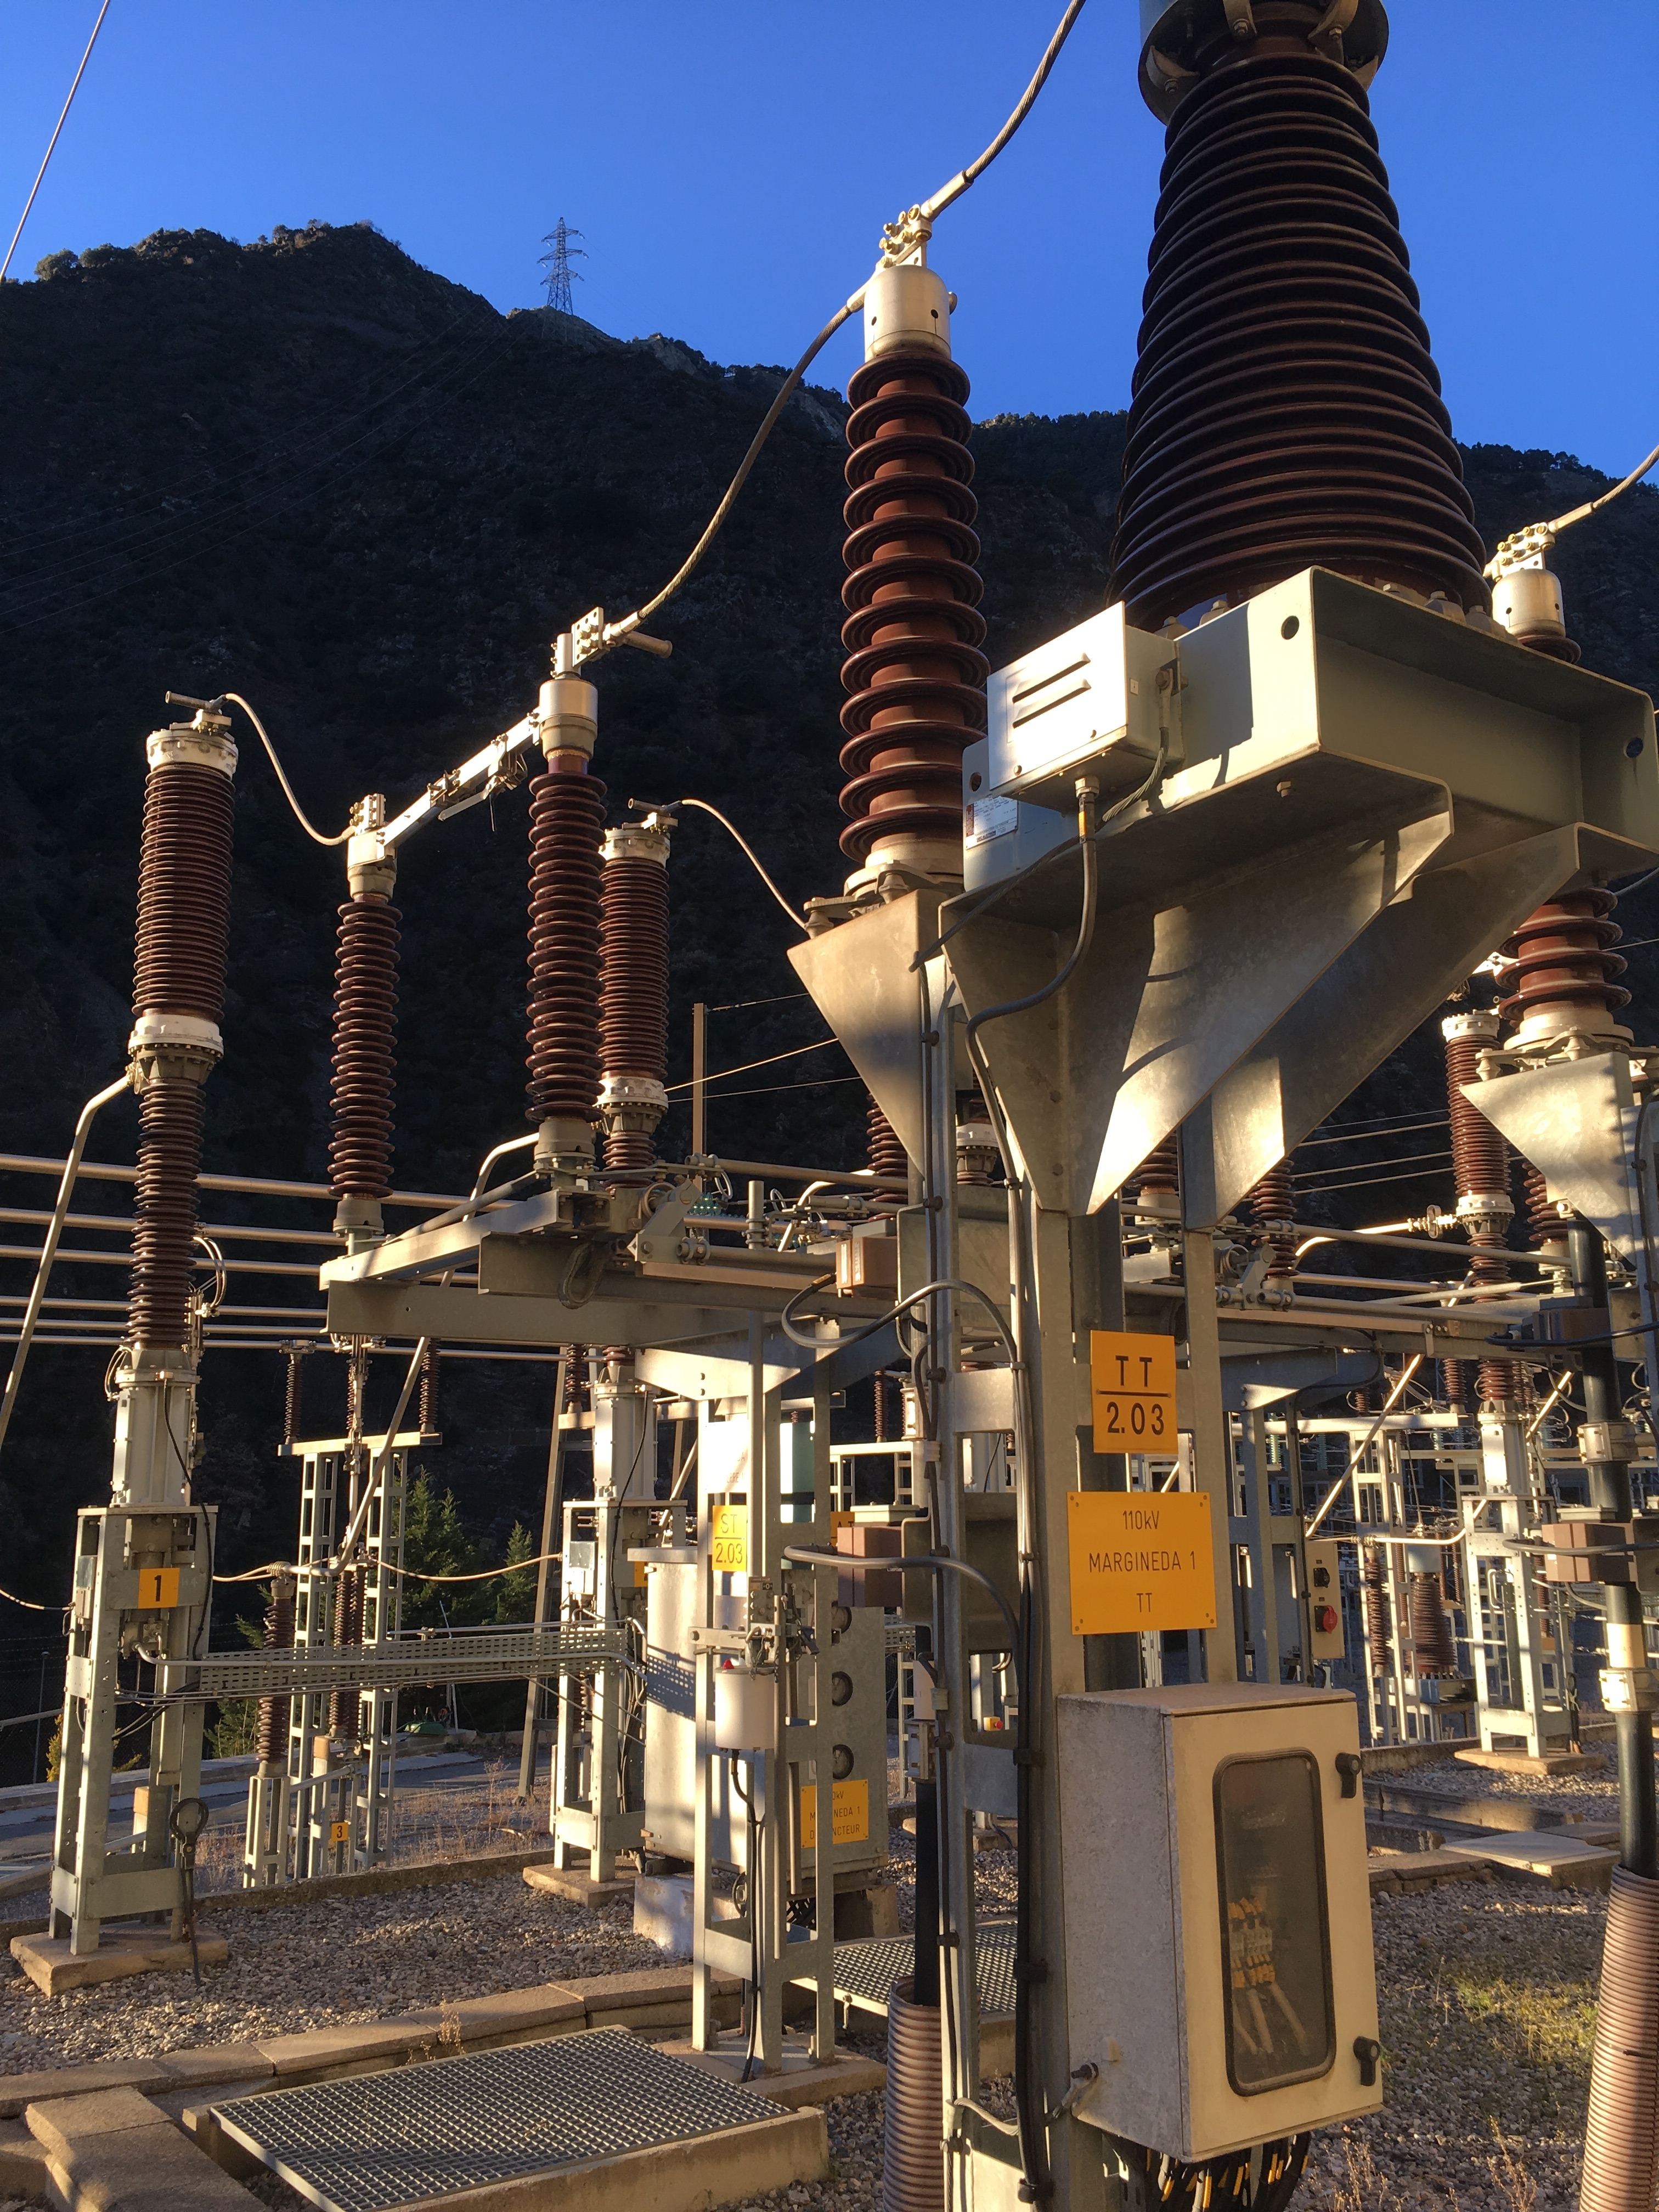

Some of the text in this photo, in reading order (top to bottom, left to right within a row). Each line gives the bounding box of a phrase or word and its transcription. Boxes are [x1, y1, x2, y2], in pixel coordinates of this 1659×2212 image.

[1115, 1355, 1153, 1387] TT
[1107, 1401, 1164, 1436] 2.03
[721, 1513, 737, 1533] ST
[1122, 1510, 1159, 1530] 110kV
[716, 1542, 743, 1564] 2.03
[1089, 1550, 1195, 1573] MARGINEDA 1
[154, 1575, 162, 1602] 1
[1136, 1593, 1153, 1612] TT
[857, 1806, 860, 1814] 1
[336, 1825, 343, 1838] 3
